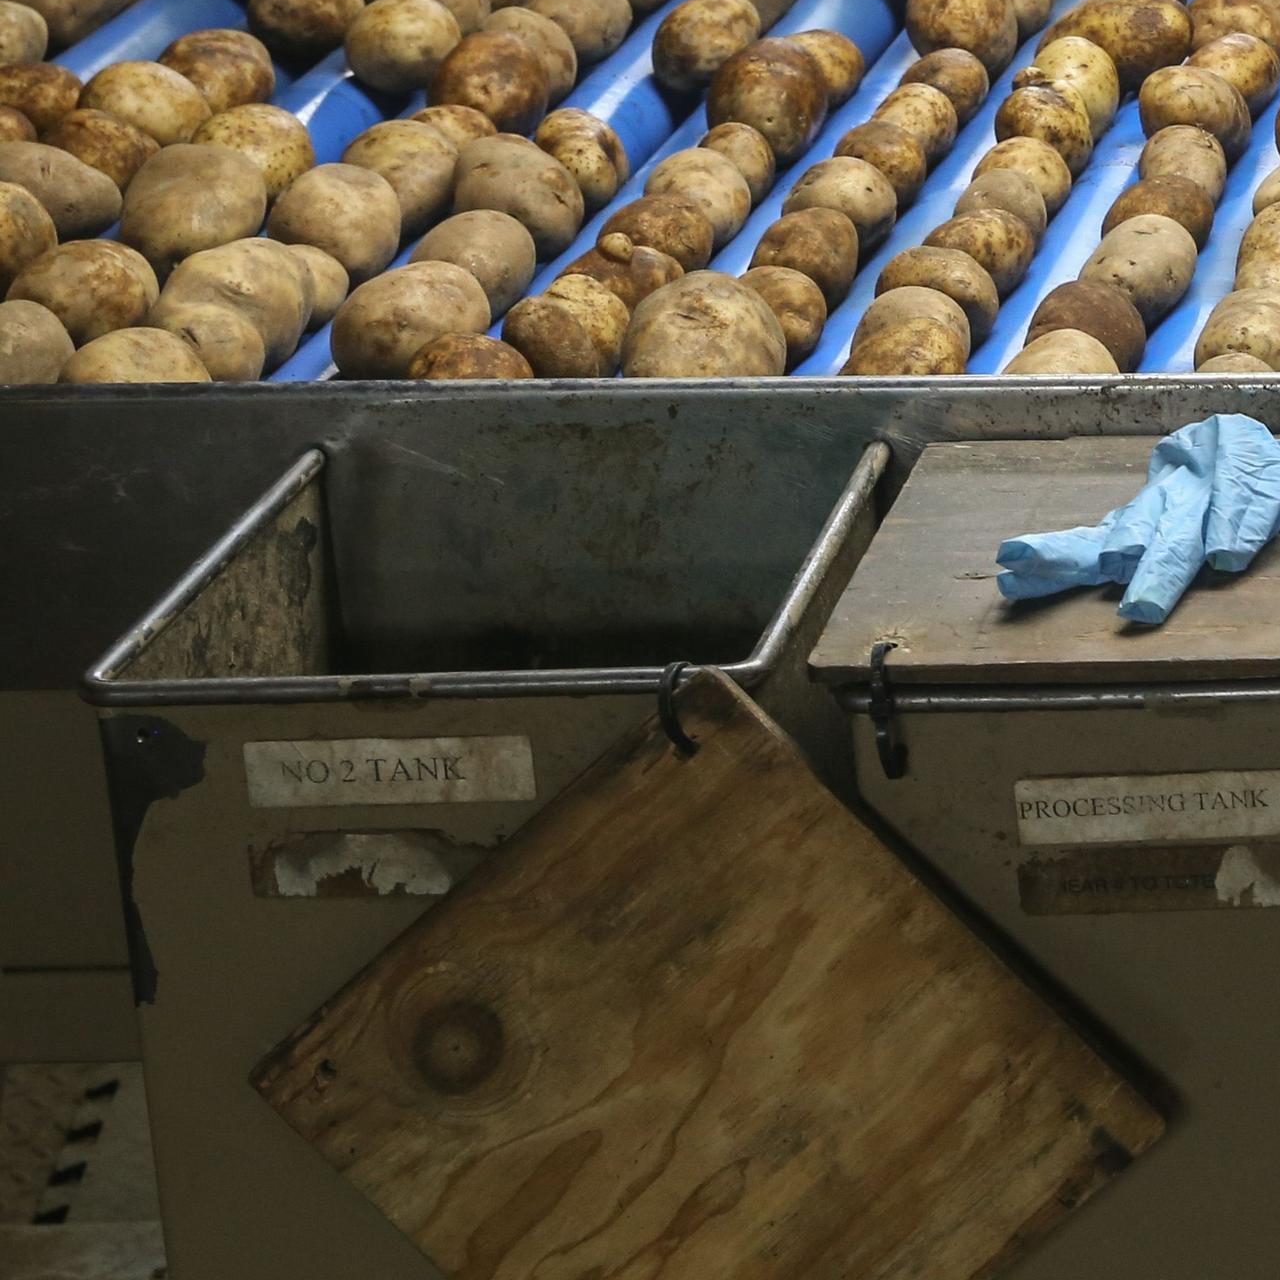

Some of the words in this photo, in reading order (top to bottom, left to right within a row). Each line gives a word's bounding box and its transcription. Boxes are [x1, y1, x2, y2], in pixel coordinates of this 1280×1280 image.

[281, 759, 330, 784] NO
[340, 759, 356, 783] 2
[366, 756, 467, 783] TANK
[1019, 793, 1186, 821] PROCESSING
[1194, 787, 1269, 812] TANK
